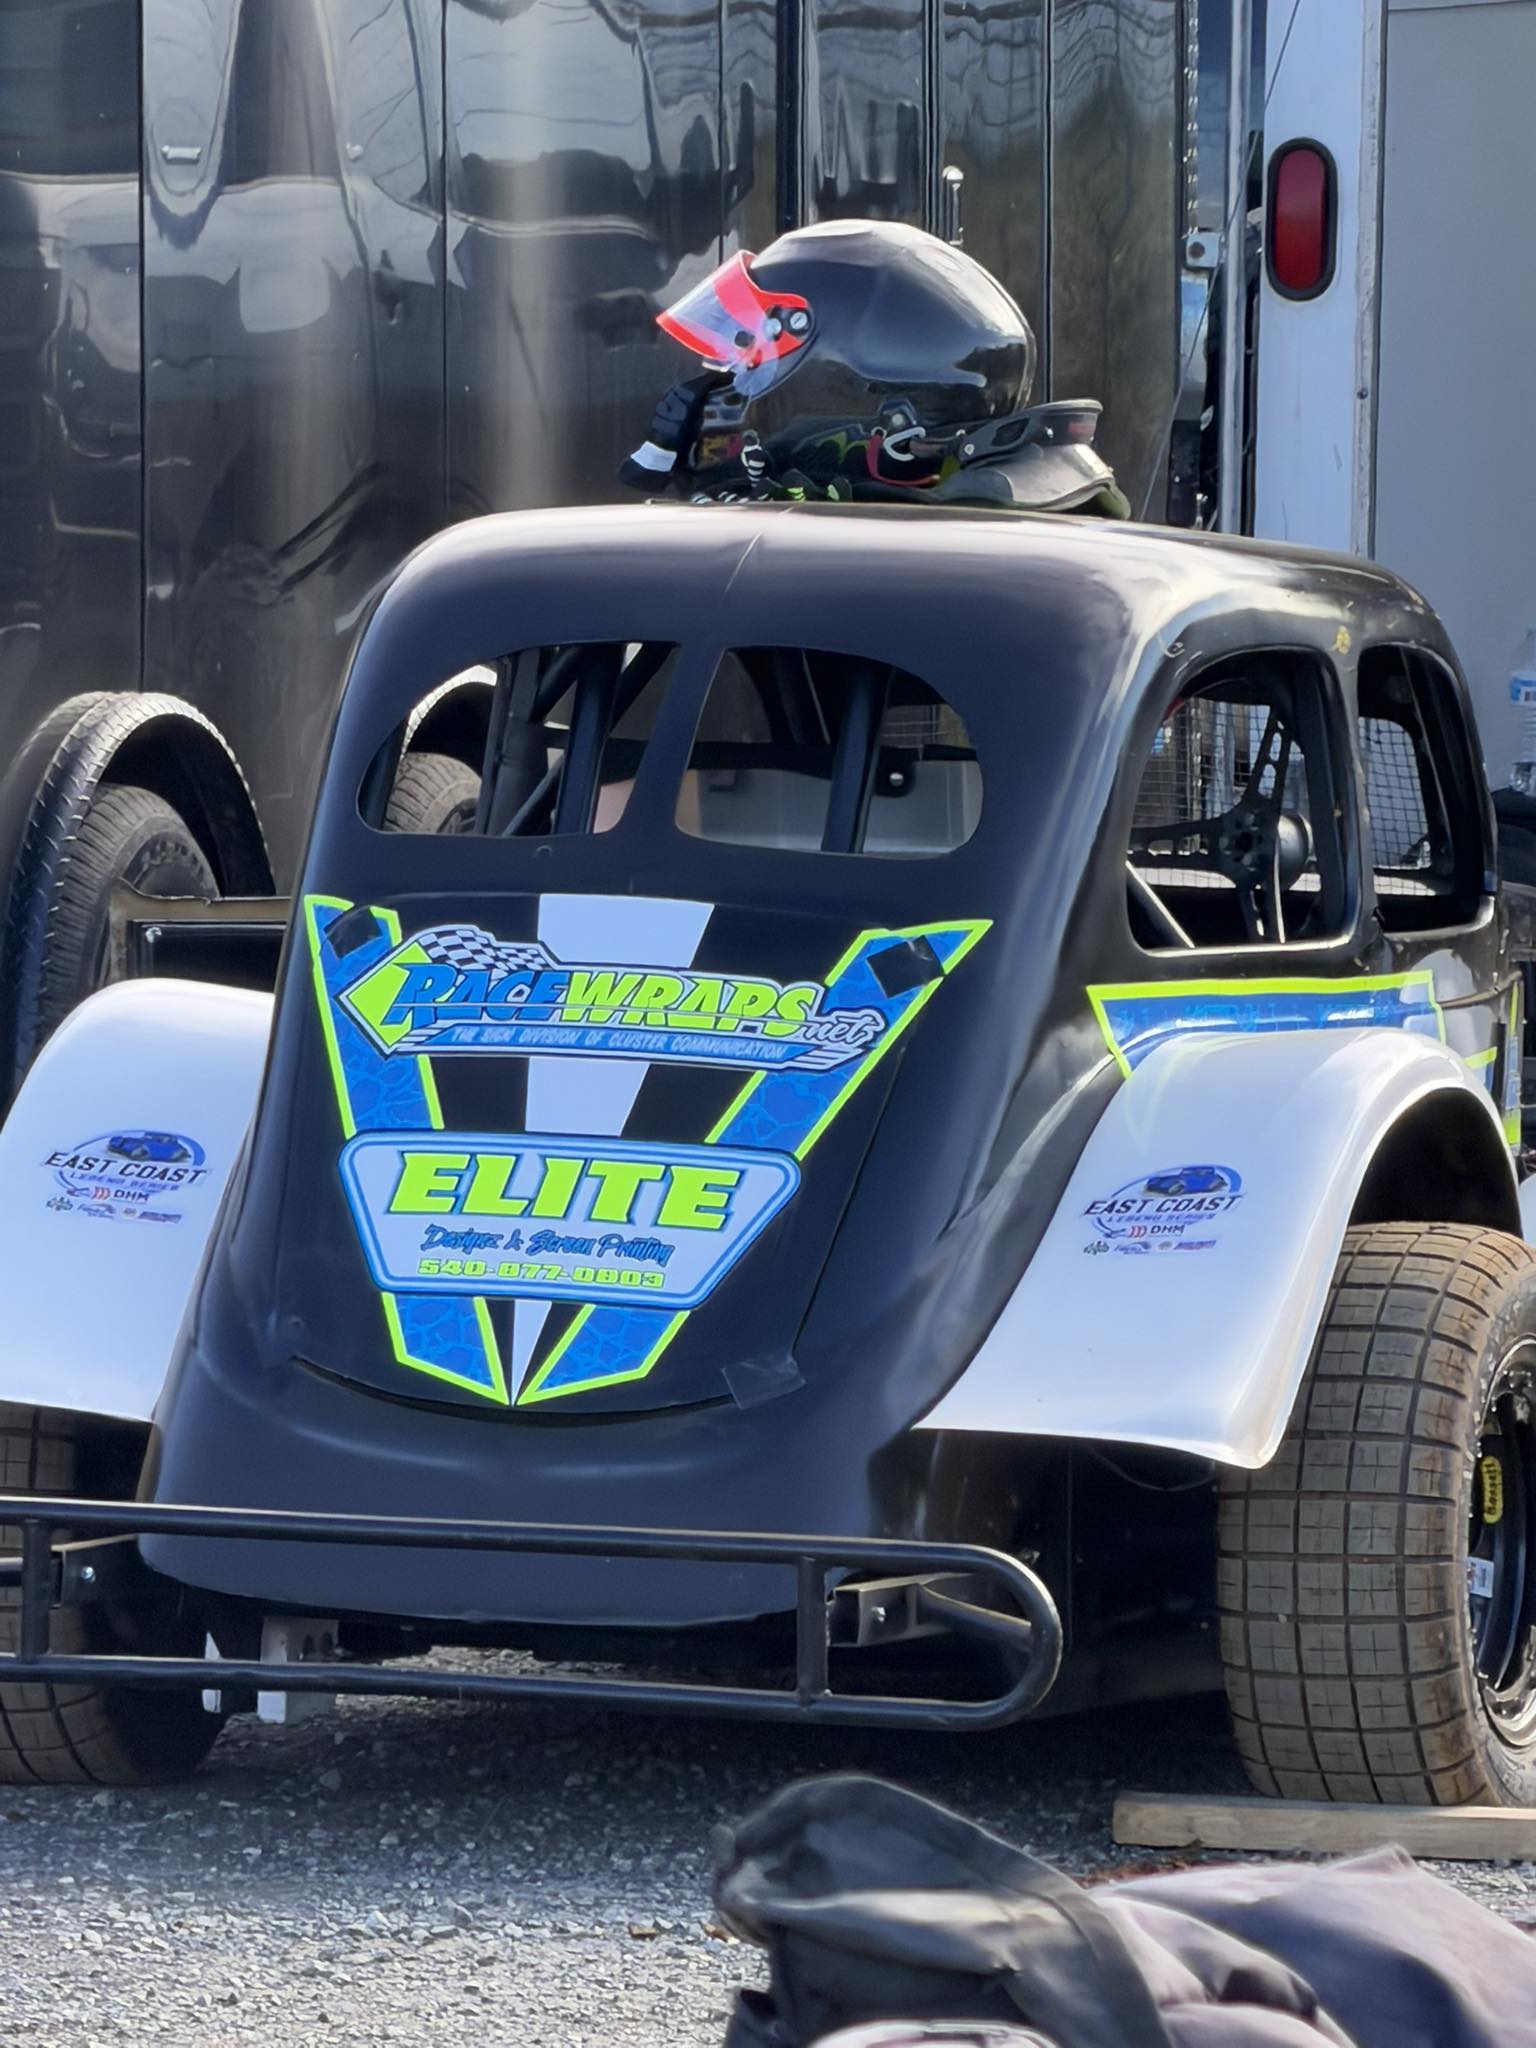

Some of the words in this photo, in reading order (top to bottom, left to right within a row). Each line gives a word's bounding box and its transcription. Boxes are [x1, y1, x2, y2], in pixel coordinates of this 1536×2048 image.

[481, 1027, 515, 1043] SIGN
[519, 1028, 580, 1046] DIVISION
[584, 1031, 602, 1046] OF
[607, 1031, 668, 1050] CLUSTER
[670, 1035, 789, 1059] COMMUNICATION
[45, 1151, 117, 1173] EAST
[118, 1163, 207, 1184] COAST
[113, 1188, 150, 1202] DHM
[388, 1151, 743, 1231] ELITE
[1084, 1199, 1153, 1216] EAST
[1155, 1195, 1243, 1213] COAST
[1150, 1225, 1185, 1234] DHM
[503, 1228, 525, 1251] &
[525, 1229, 597, 1256] Screen
[596, 1233, 675, 1267] Printing
